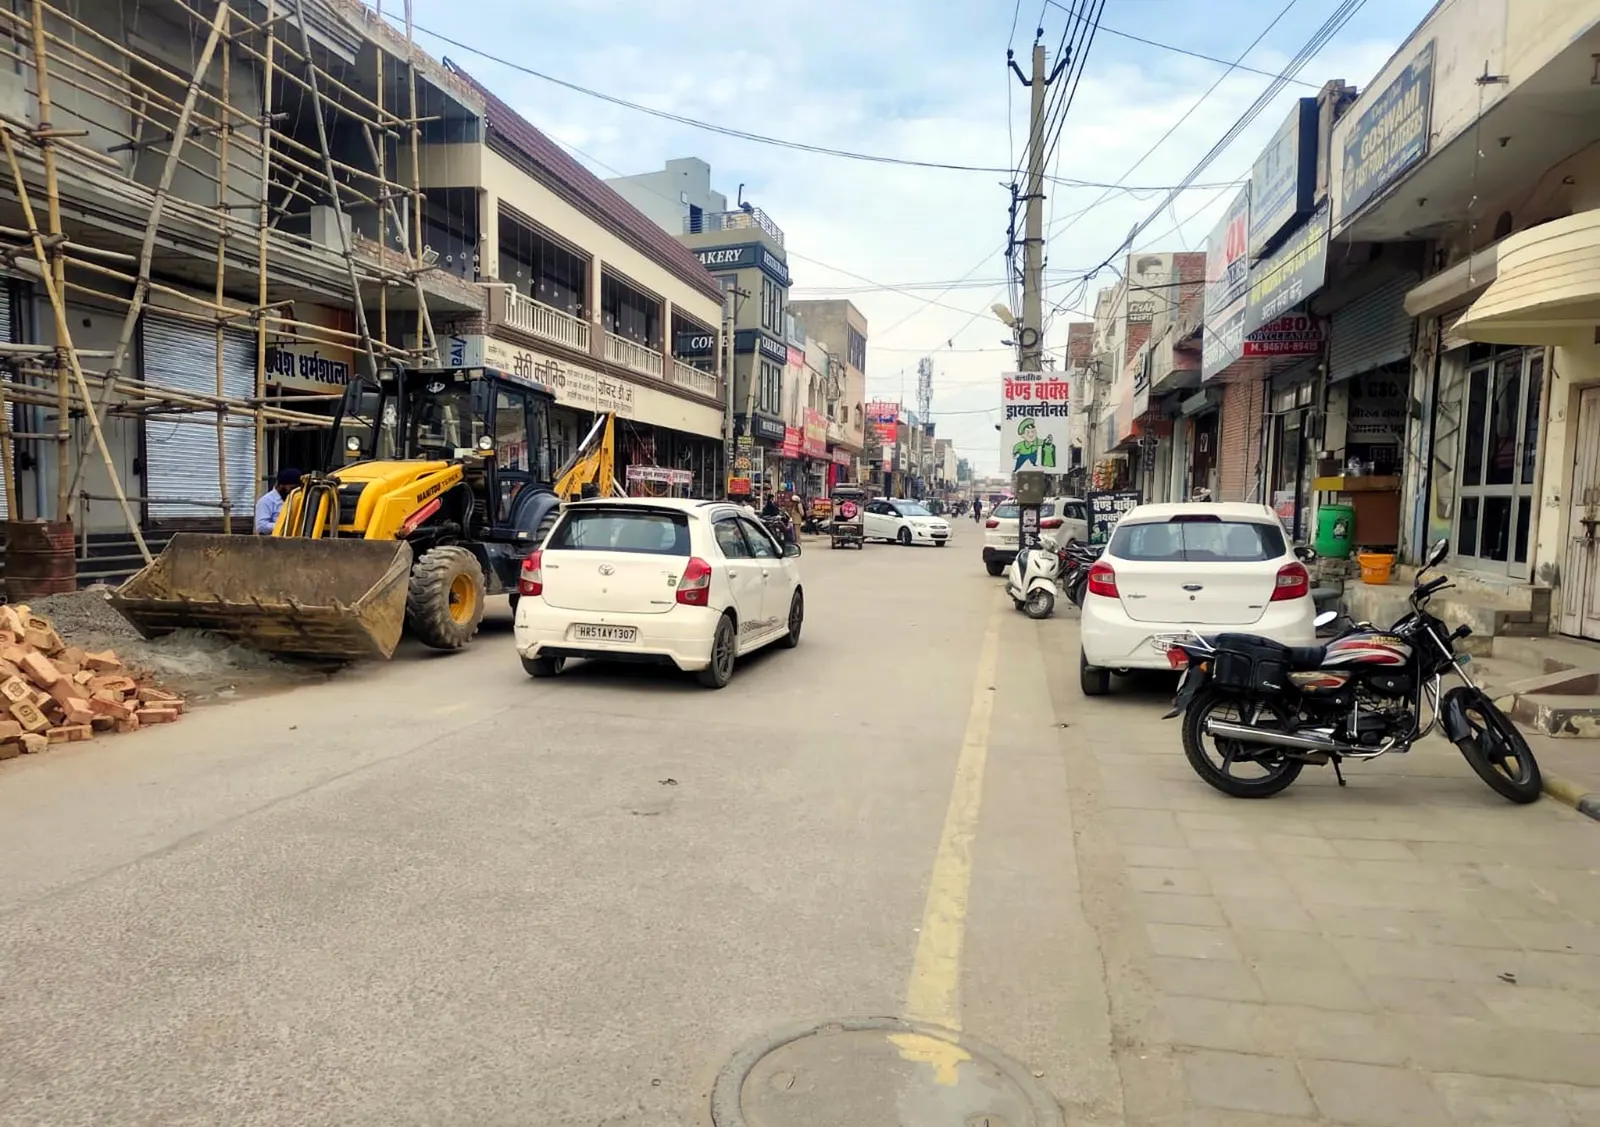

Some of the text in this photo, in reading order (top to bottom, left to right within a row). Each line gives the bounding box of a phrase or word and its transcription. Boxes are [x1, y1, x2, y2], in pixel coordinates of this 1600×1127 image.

[1360, 81, 1421, 160] GOSWAMI
[299, 350, 349, 386] धर्मशाला
[513, 351, 532, 380] सेठी
[534, 359, 566, 389] क्लीनिक
[416, 482, 441, 504] MANITOU
[580, 626, 635, 640] HR51AV1307
